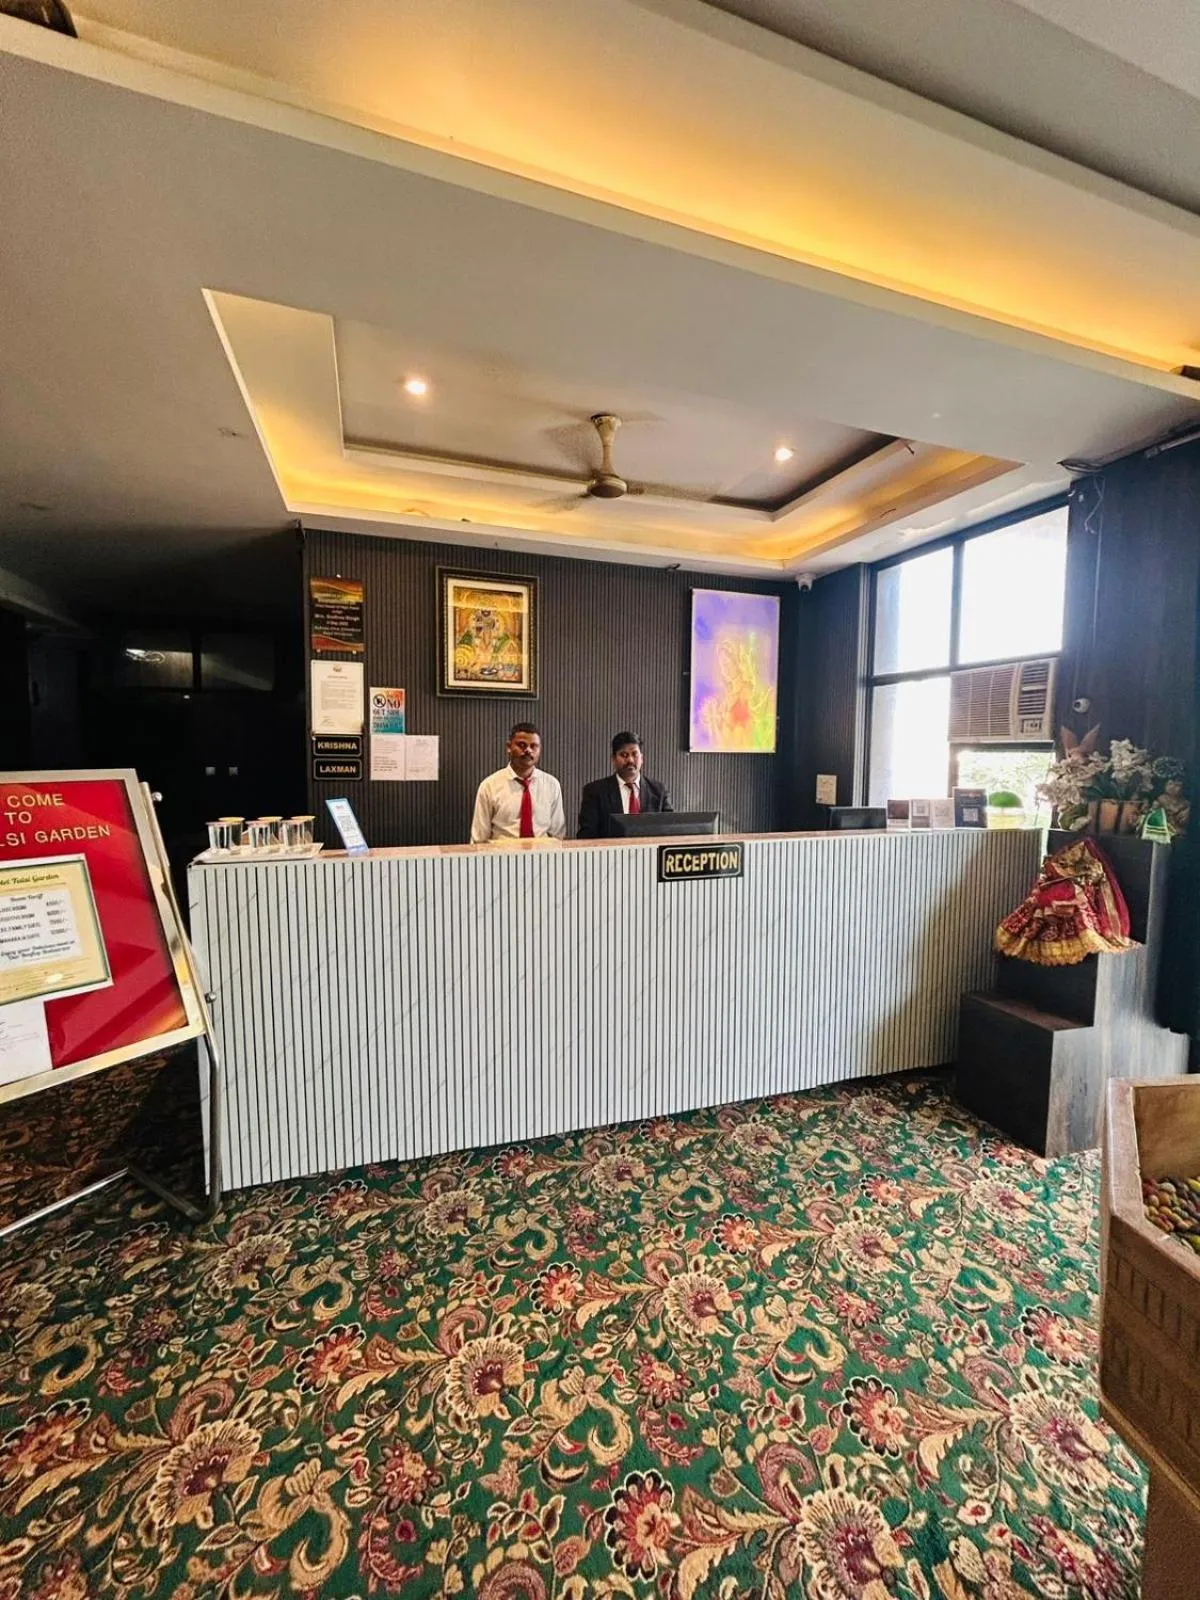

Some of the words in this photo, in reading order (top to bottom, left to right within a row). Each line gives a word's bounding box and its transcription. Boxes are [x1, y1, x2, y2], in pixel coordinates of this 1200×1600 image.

[317, 741, 357, 750] KRISHNA
[319, 765, 356, 774] LAXMAN
[6, 793, 65, 808] COME
[4, 811, 32, 825] TO
[34, 825, 111, 843] GARDEN
[665, 851, 738, 873] RECEPTION
